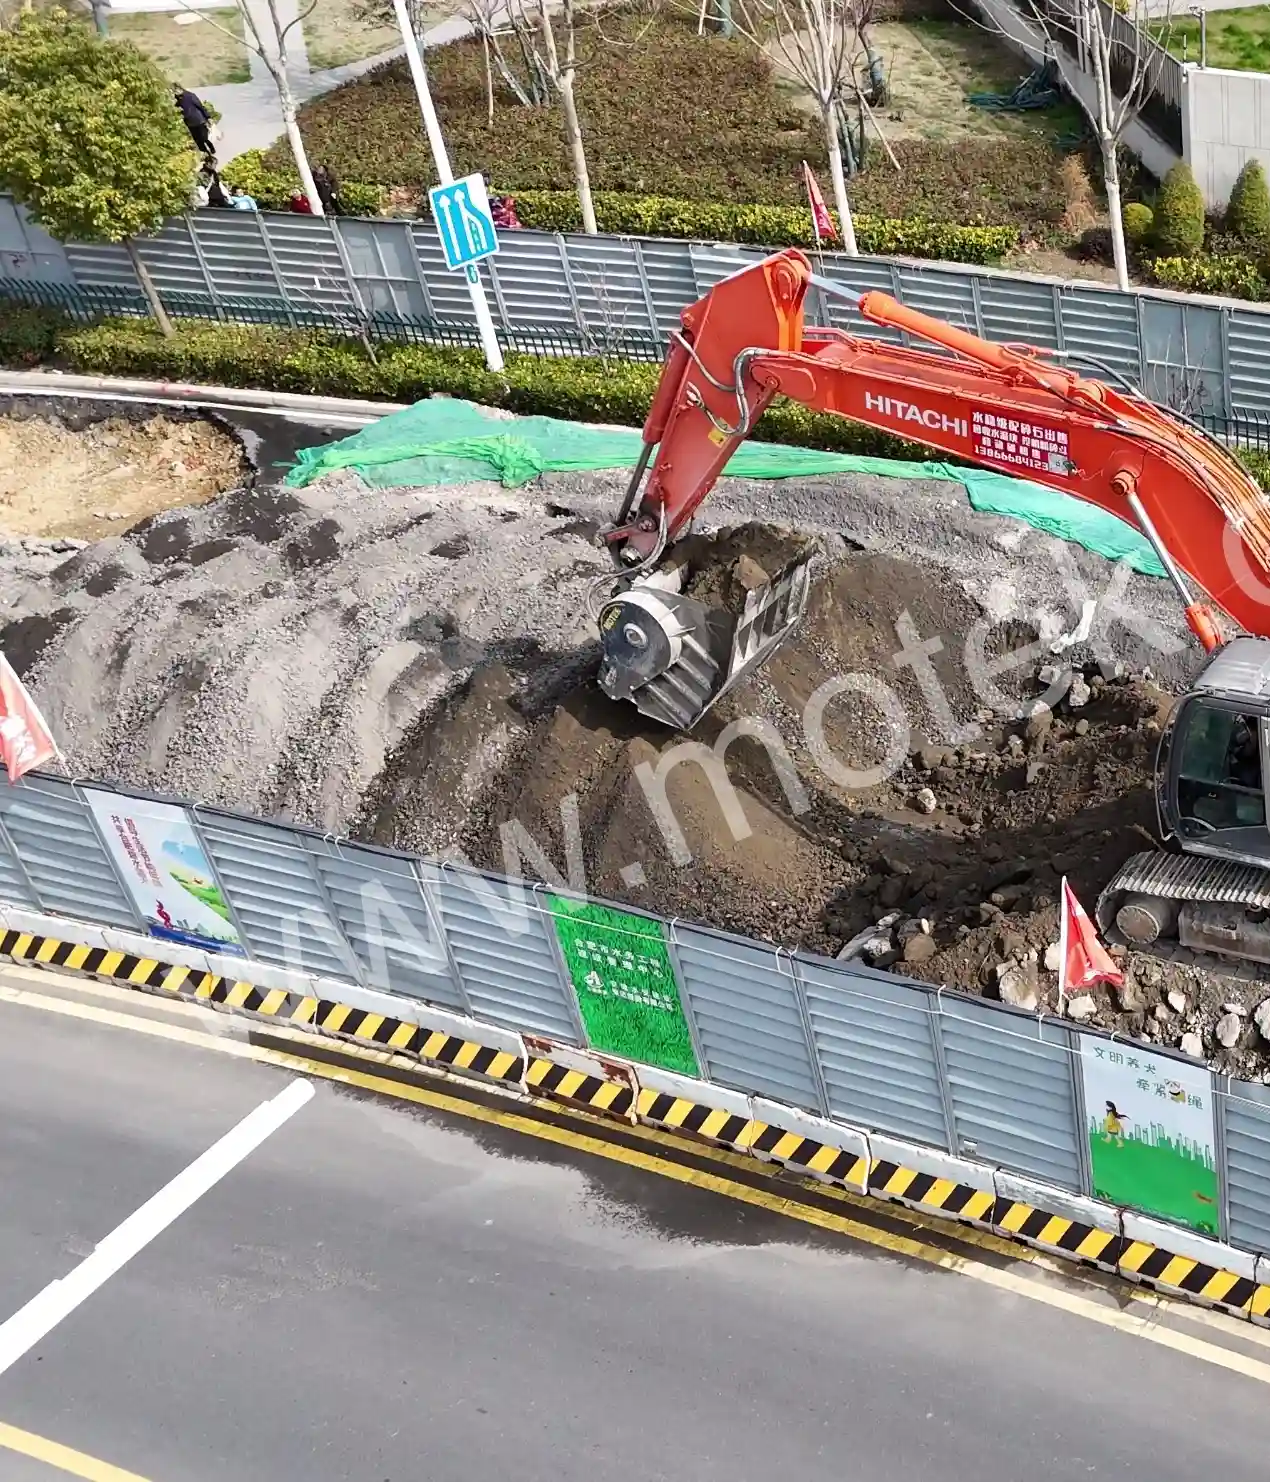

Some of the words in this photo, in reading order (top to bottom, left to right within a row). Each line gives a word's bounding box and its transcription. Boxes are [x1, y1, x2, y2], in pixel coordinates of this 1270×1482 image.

[865, 391, 969, 437] HITACHI
[1093, 1046, 1157, 1075] 文明养犬
